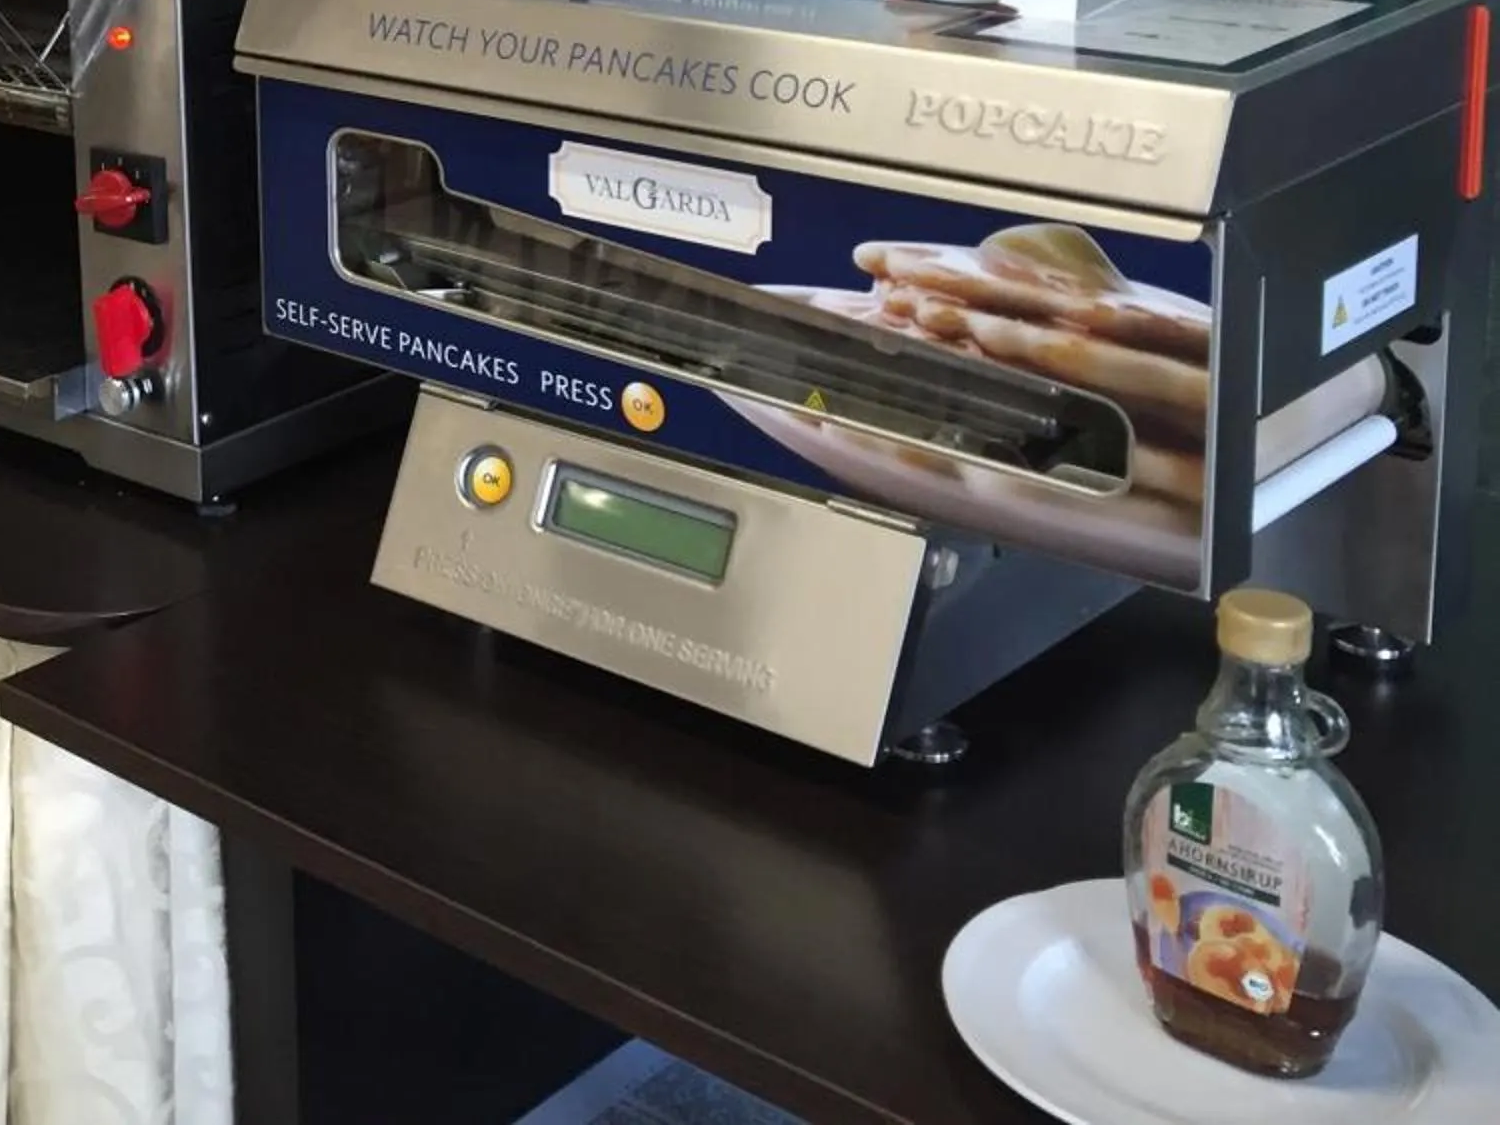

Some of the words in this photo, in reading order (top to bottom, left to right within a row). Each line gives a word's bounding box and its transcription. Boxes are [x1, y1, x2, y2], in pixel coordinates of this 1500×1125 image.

[368, 12, 469, 53] WATCH
[481, 28, 560, 67] YOUR
[567, 41, 739, 96] PANCAKES
[749, 69, 856, 114] COOK
[903, 86, 1169, 166] POPCAKE
[584, 173, 732, 223] VALGARDA
[276, 298, 392, 350] SELF-SERVE
[399, 332, 520, 385] PANCAKES
[540, 370, 613, 411] PRESS
[632, 398, 654, 416] OK
[482, 472, 500, 487] OK
[627, 620, 676, 660] ONE
[676, 638, 779, 696] SERVING
[1168, 838, 1283, 890] AHORNSIRUP
